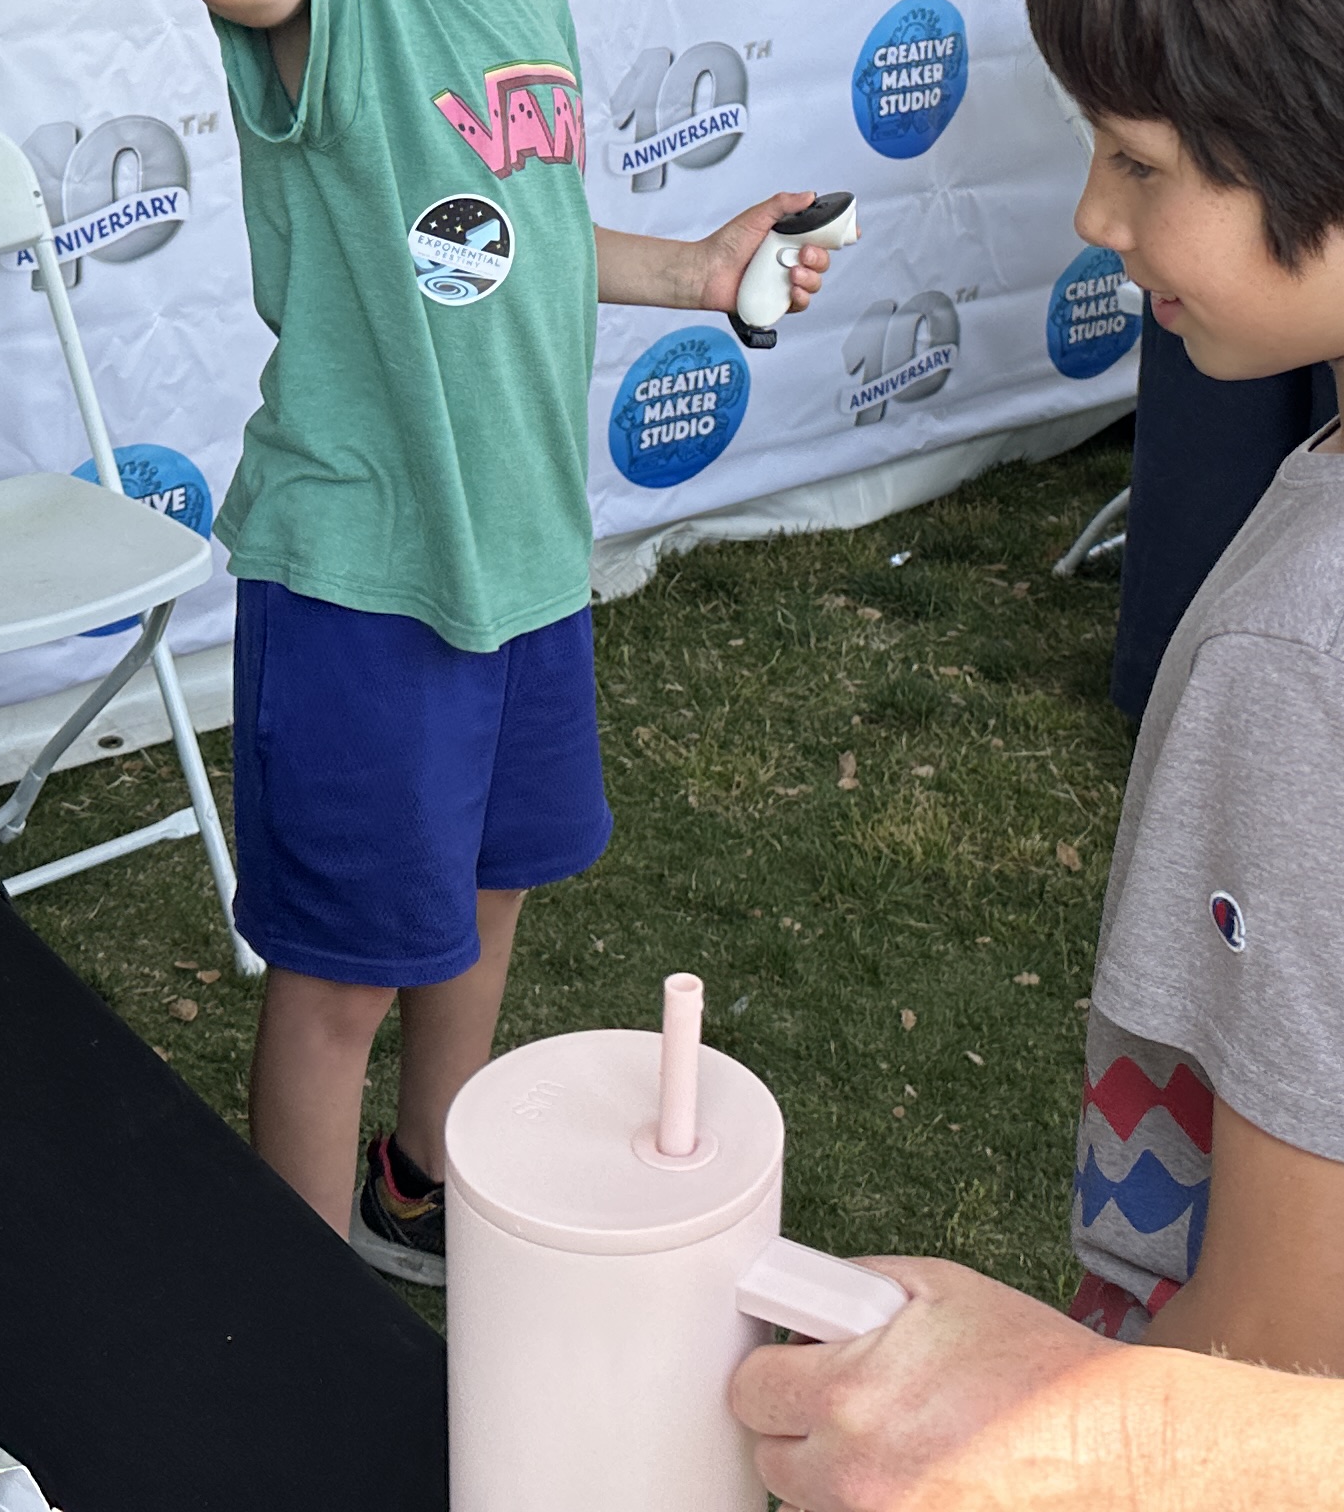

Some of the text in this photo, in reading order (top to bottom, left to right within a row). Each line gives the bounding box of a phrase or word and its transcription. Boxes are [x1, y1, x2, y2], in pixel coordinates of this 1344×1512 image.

[874, 36, 954, 67] CREATIVE
[882, 63, 943, 91] MAKER
[879, 88, 941, 117] STUDIO
[430, 59, 586, 181] VAN
[622, 108, 739, 170] ANNIVERSARY
[16, 192, 178, 266] ANIVERSARY
[417, 235, 501, 267] EXPONENTIAL
[435, 250, 480, 268] DESTINY
[1065, 271, 1129, 301] CREATIV
[1071, 296, 1118, 321] MAKE
[1068, 315, 1126, 344] STUDIO
[635, 364, 730, 402] CREATIVE
[850, 348, 951, 409] ANNIVERSARY
[644, 391, 717, 424] MAKER
[639, 415, 715, 449] STUDIO
